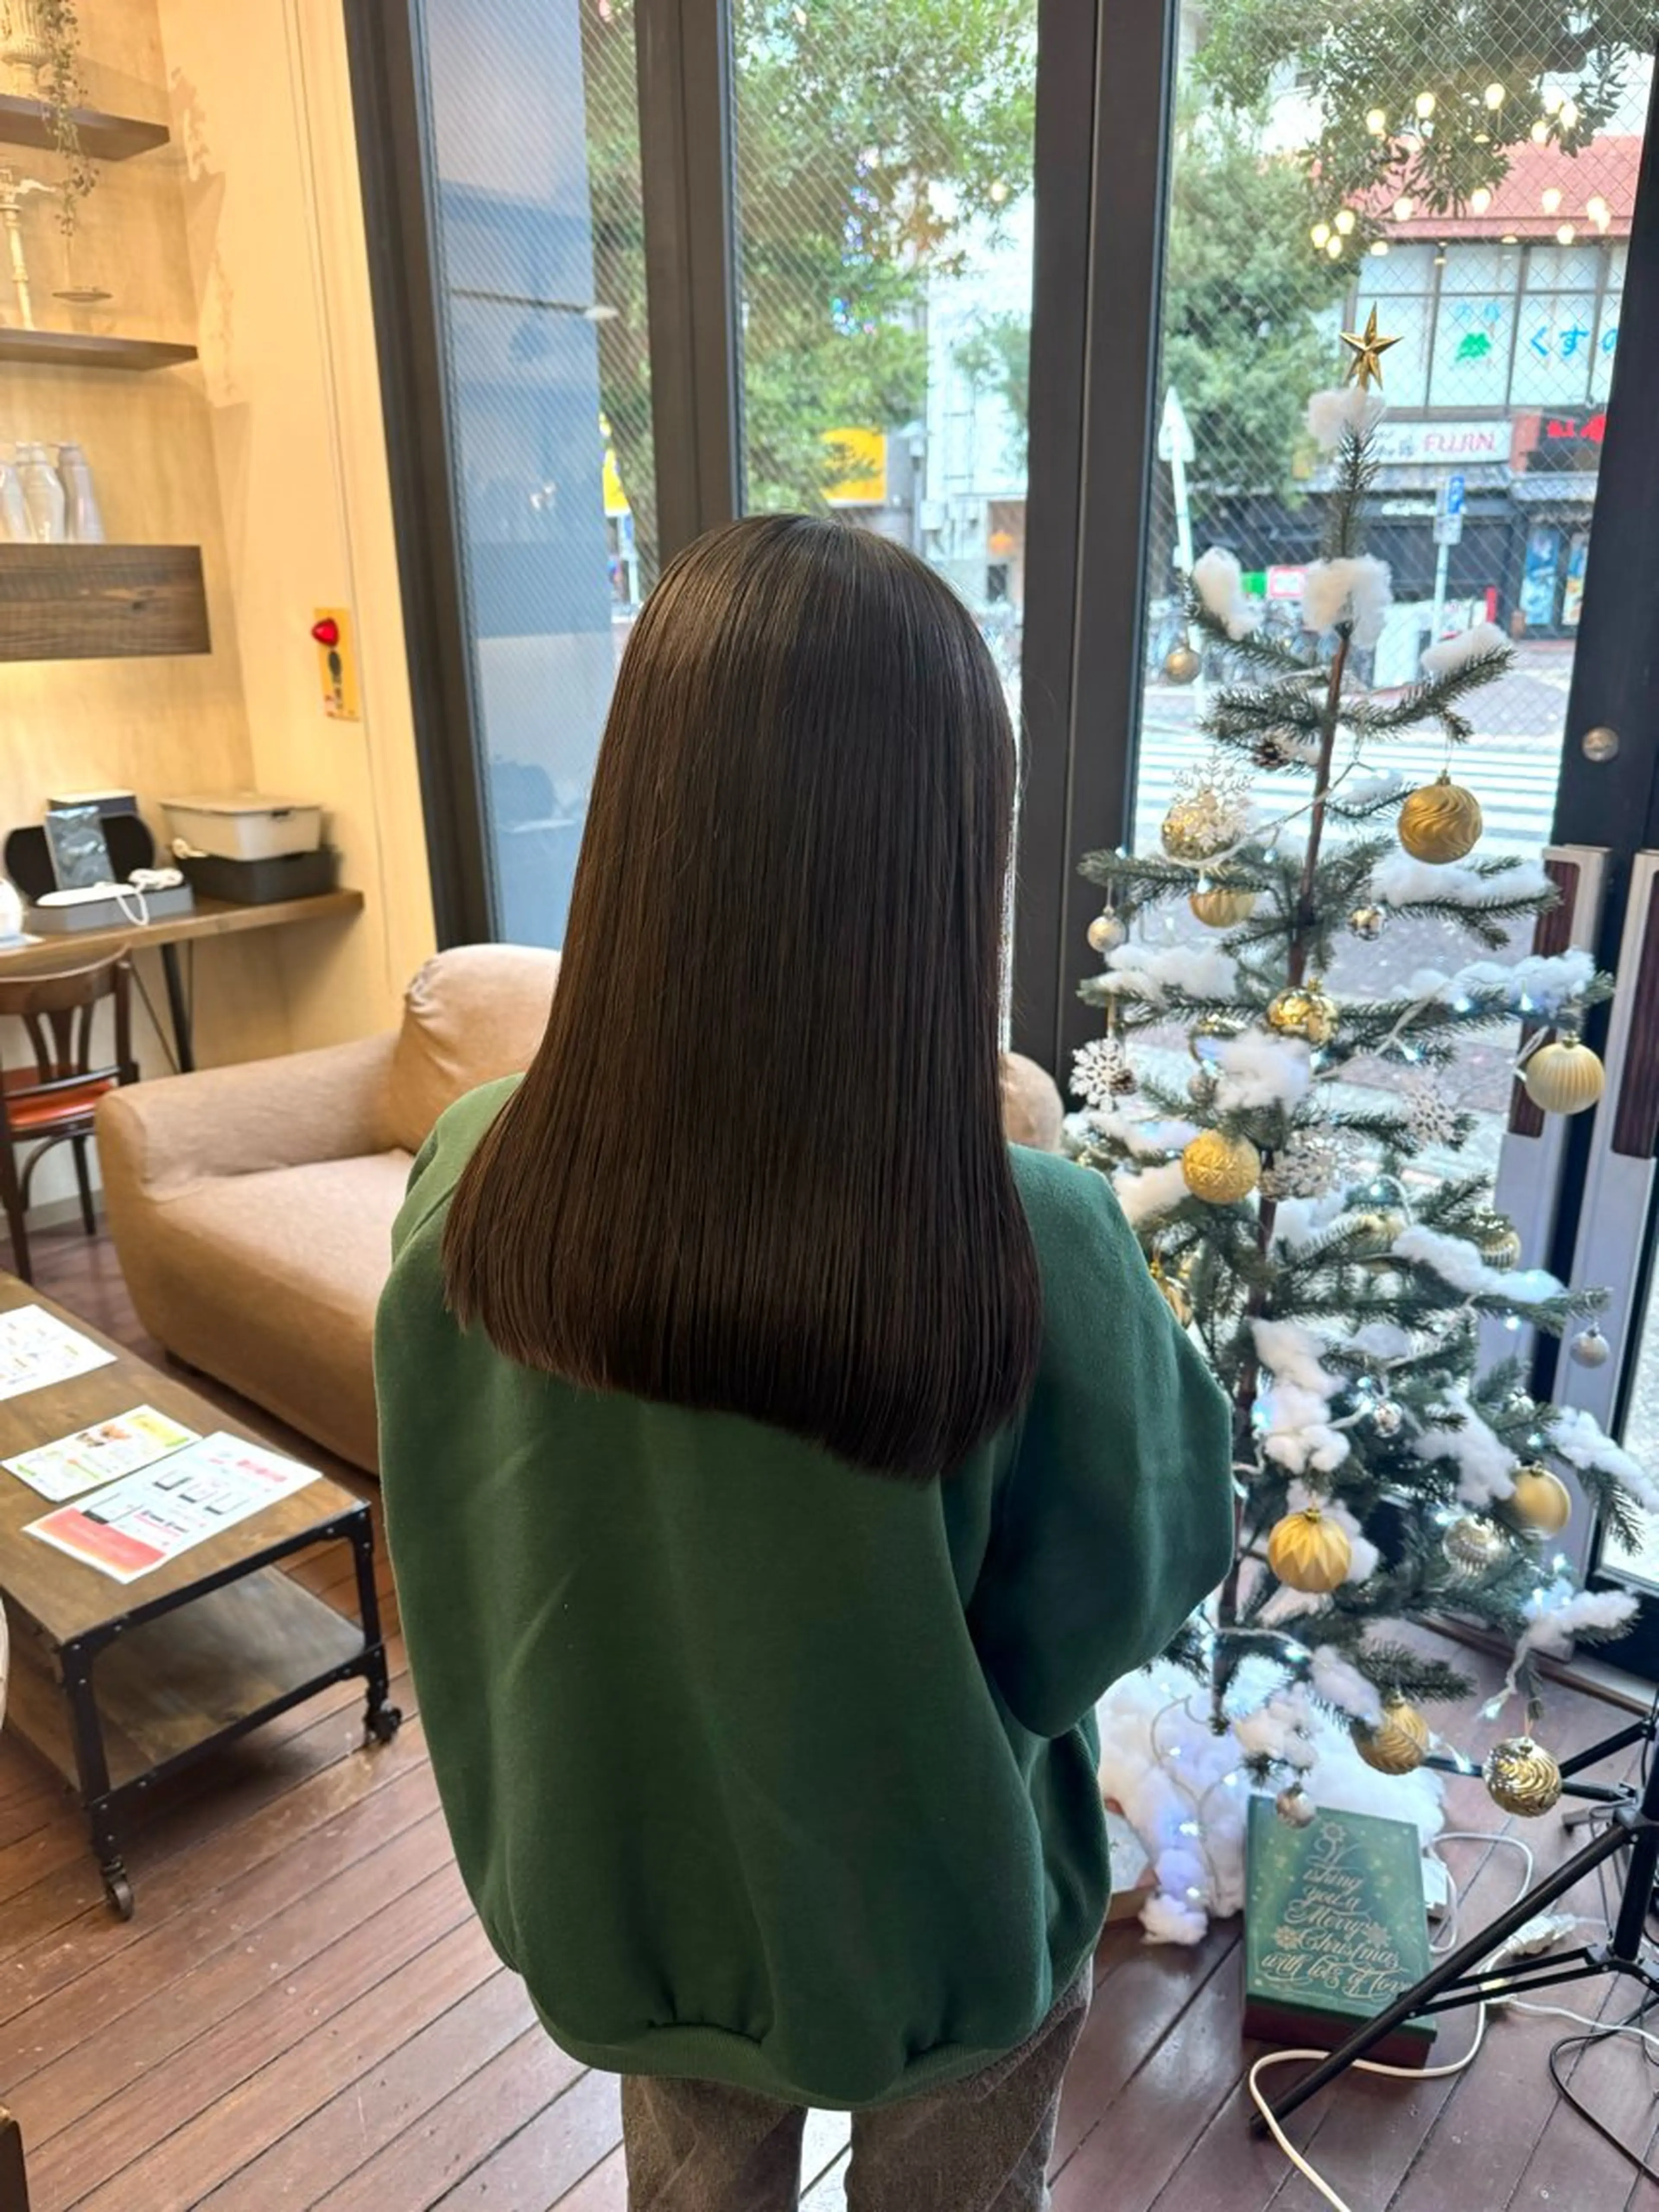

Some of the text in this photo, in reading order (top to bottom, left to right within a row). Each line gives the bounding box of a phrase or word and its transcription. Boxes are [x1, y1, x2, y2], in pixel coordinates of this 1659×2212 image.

[1299, 1885, 1338, 1908] you
[1284, 1904, 1368, 1941] Merry
[1297, 1928, 1400, 1968] Christmas
[1261, 1953, 1313, 1986] with
[1308, 1955, 1344, 1988] lots
